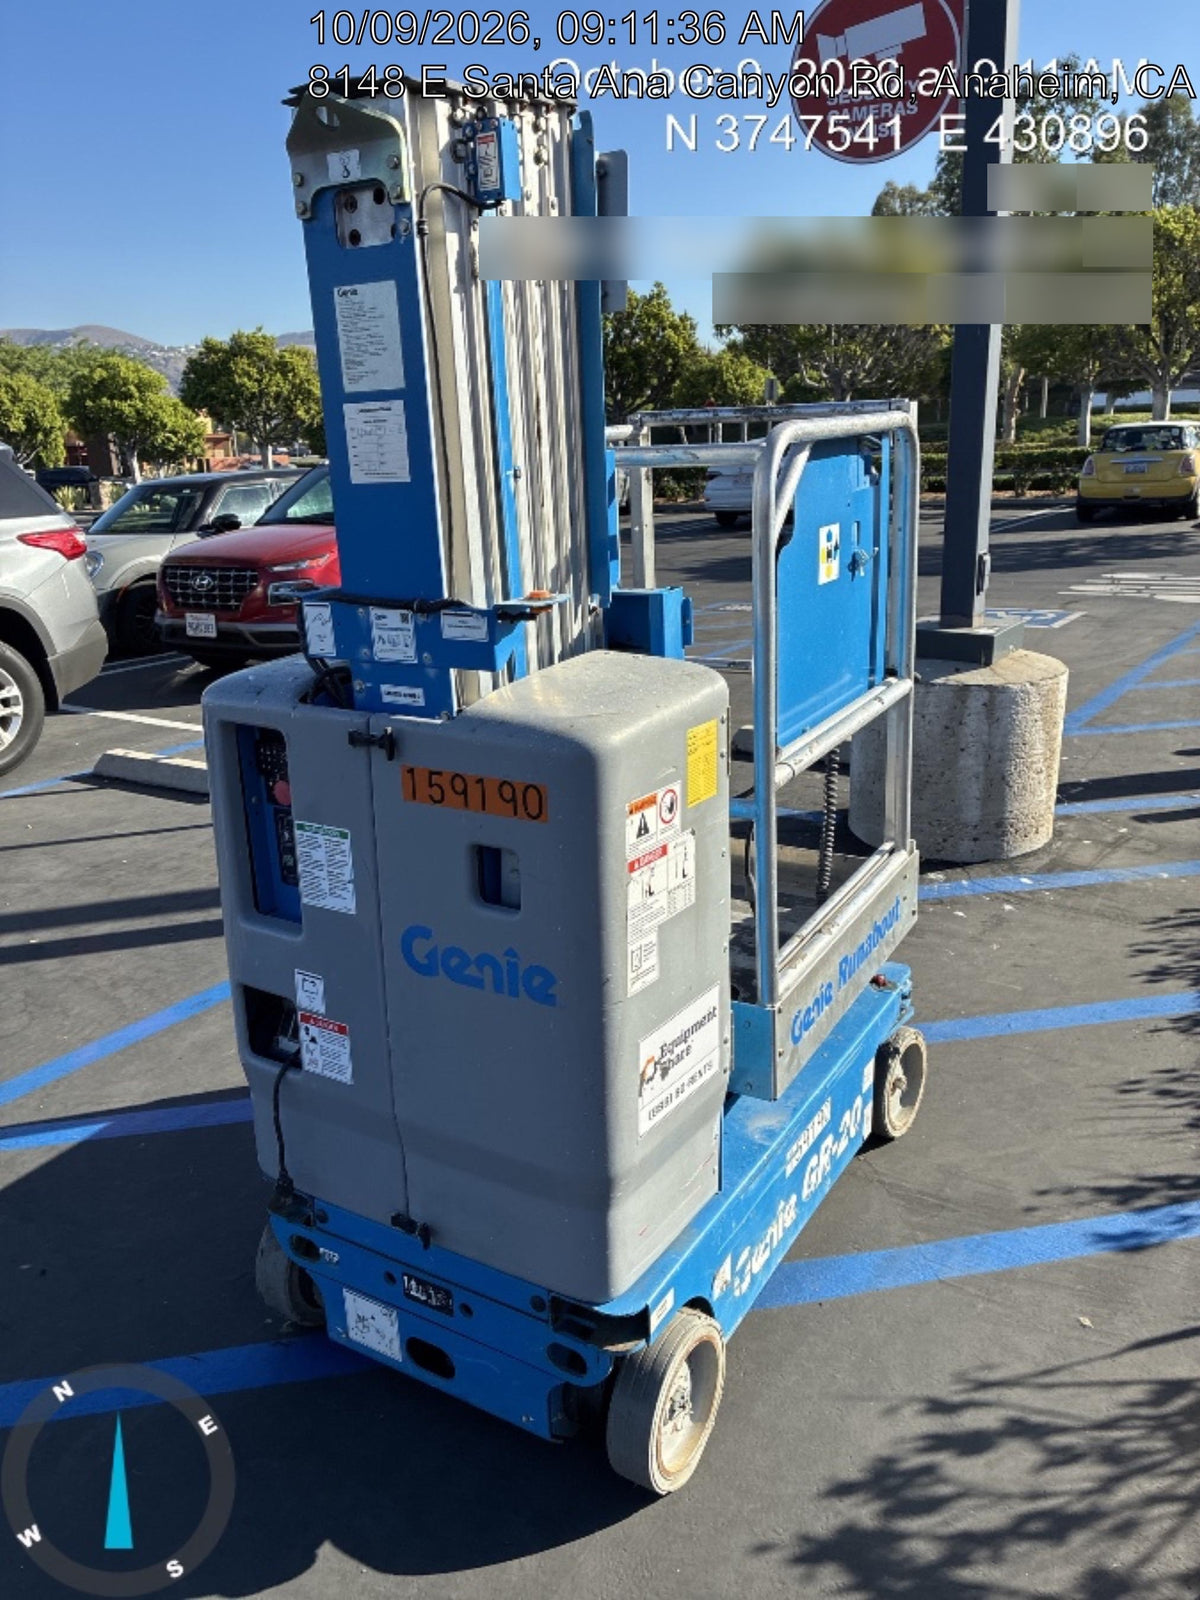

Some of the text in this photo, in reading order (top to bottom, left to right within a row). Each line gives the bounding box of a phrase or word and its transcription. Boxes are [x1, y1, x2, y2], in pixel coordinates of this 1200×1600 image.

[406, 767, 544, 820] 159190
[400, 924, 557, 1007] Genie
[659, 1005, 718, 1060] Equipment
[790, 980, 833, 1045] Genie
